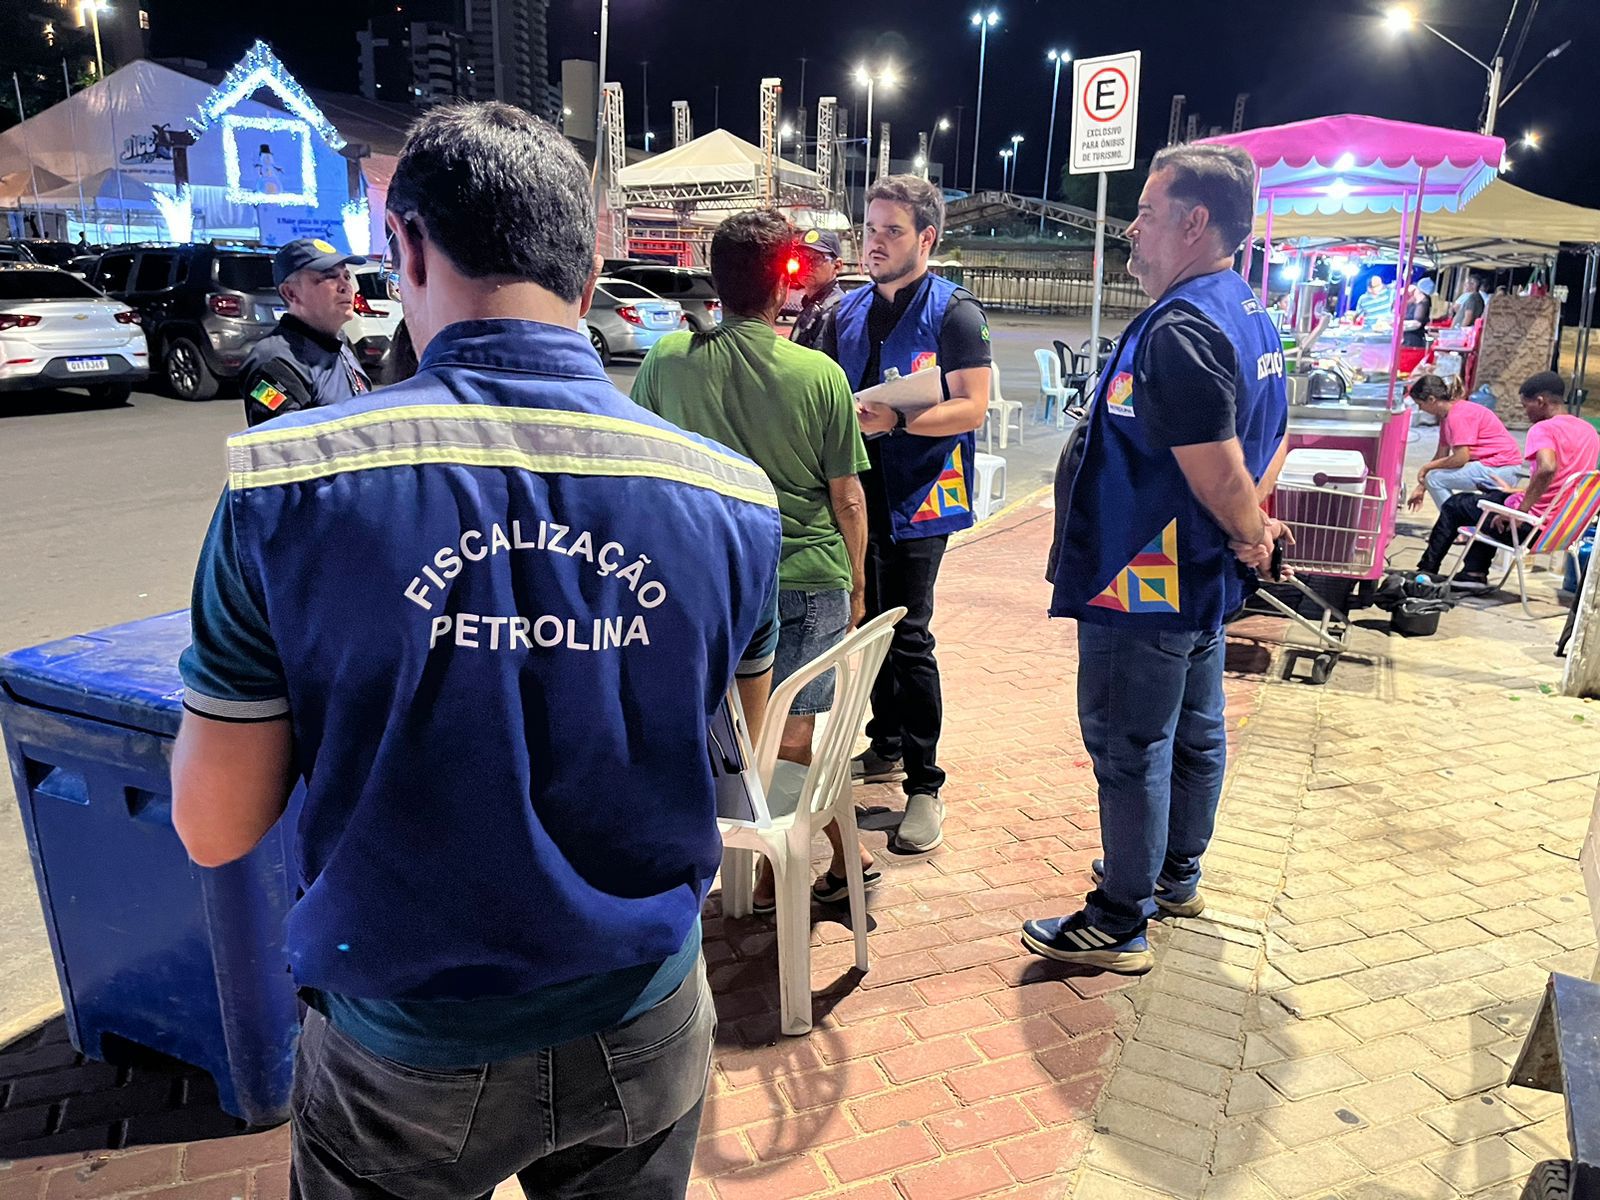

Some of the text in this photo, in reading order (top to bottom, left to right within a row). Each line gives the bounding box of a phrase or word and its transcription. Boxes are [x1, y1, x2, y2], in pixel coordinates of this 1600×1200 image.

[1096, 79, 1116, 110] E
[1086, 126, 1121, 138] EXCLUSIVO
[1082, 137, 1125, 150] PARA ÔNIBUS
[1082, 153, 1090, 162] DE
[403, 520, 667, 610] FISCALIZAÇÃO
[429, 612, 650, 651] PETROLINA
